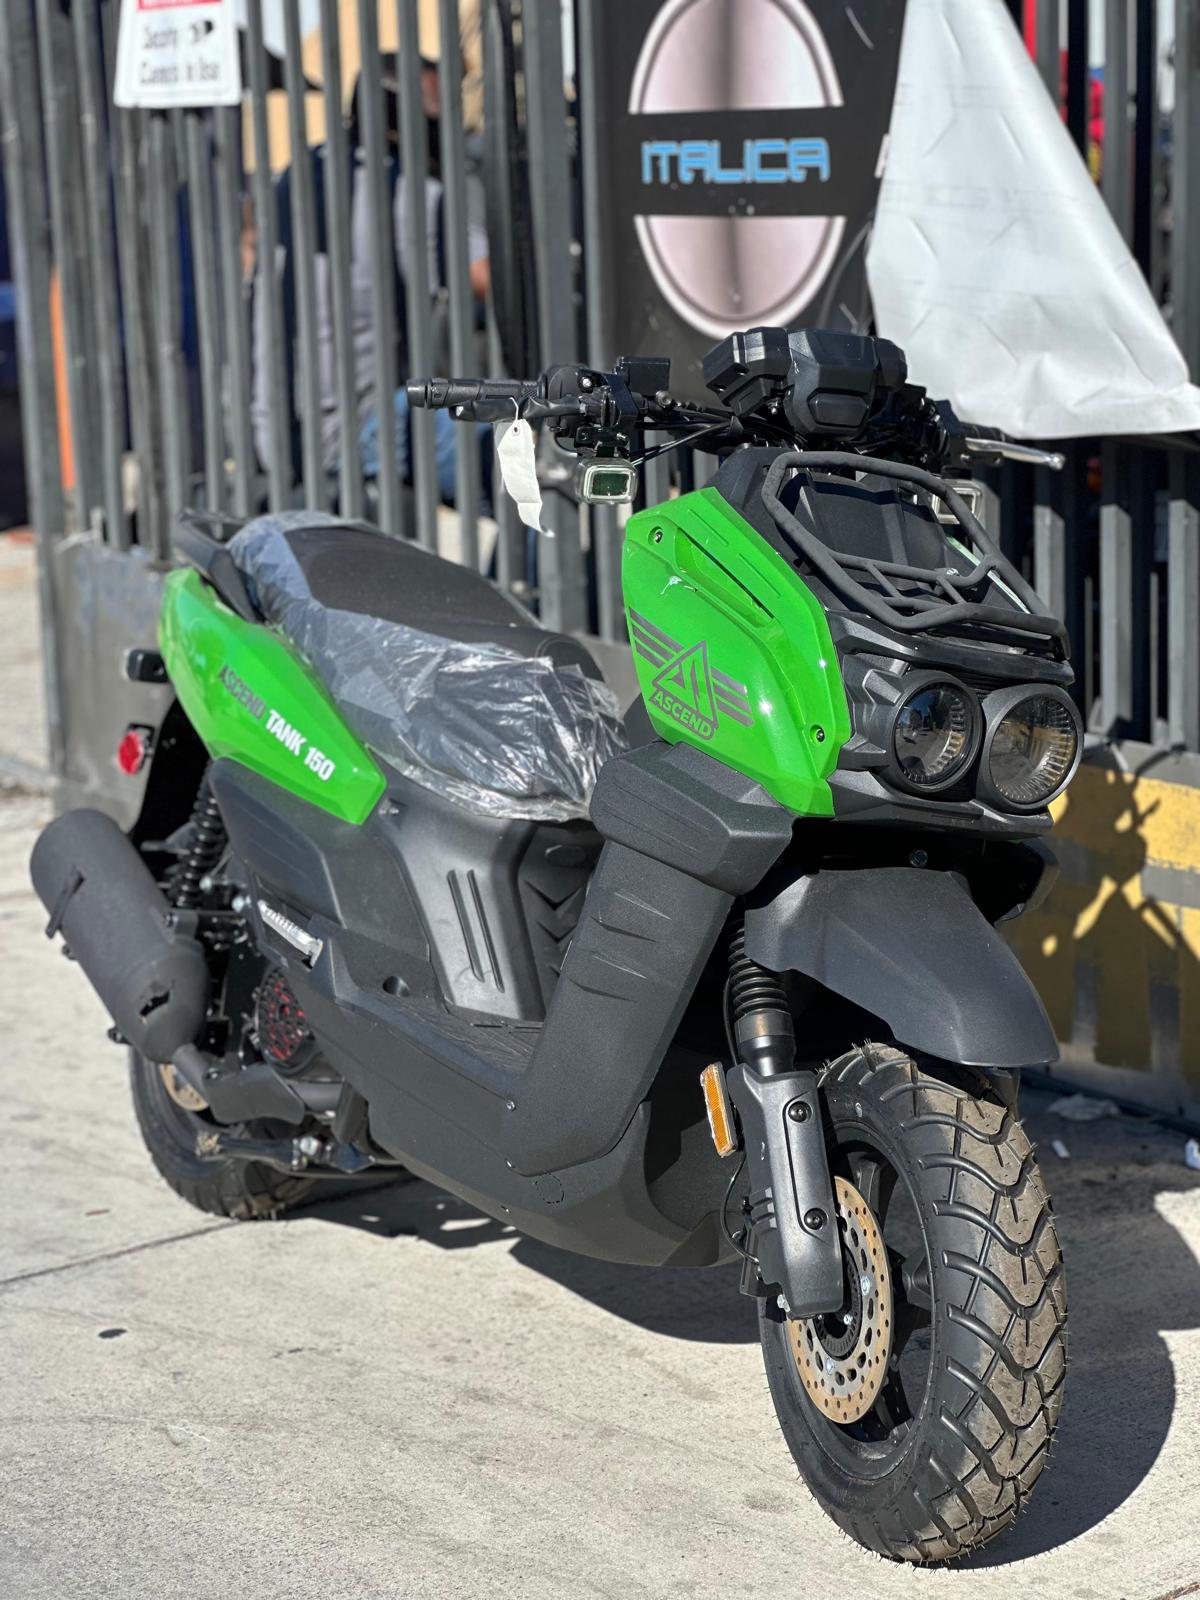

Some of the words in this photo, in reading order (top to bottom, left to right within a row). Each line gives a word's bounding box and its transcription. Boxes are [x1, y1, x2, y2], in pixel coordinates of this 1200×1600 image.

[641, 137, 831, 184] ITALICA
[218, 664, 267, 720] ASCEND
[265, 709, 307, 757] TANK
[303, 746, 336, 781] 150
[653, 691, 712, 737] ASCEND
